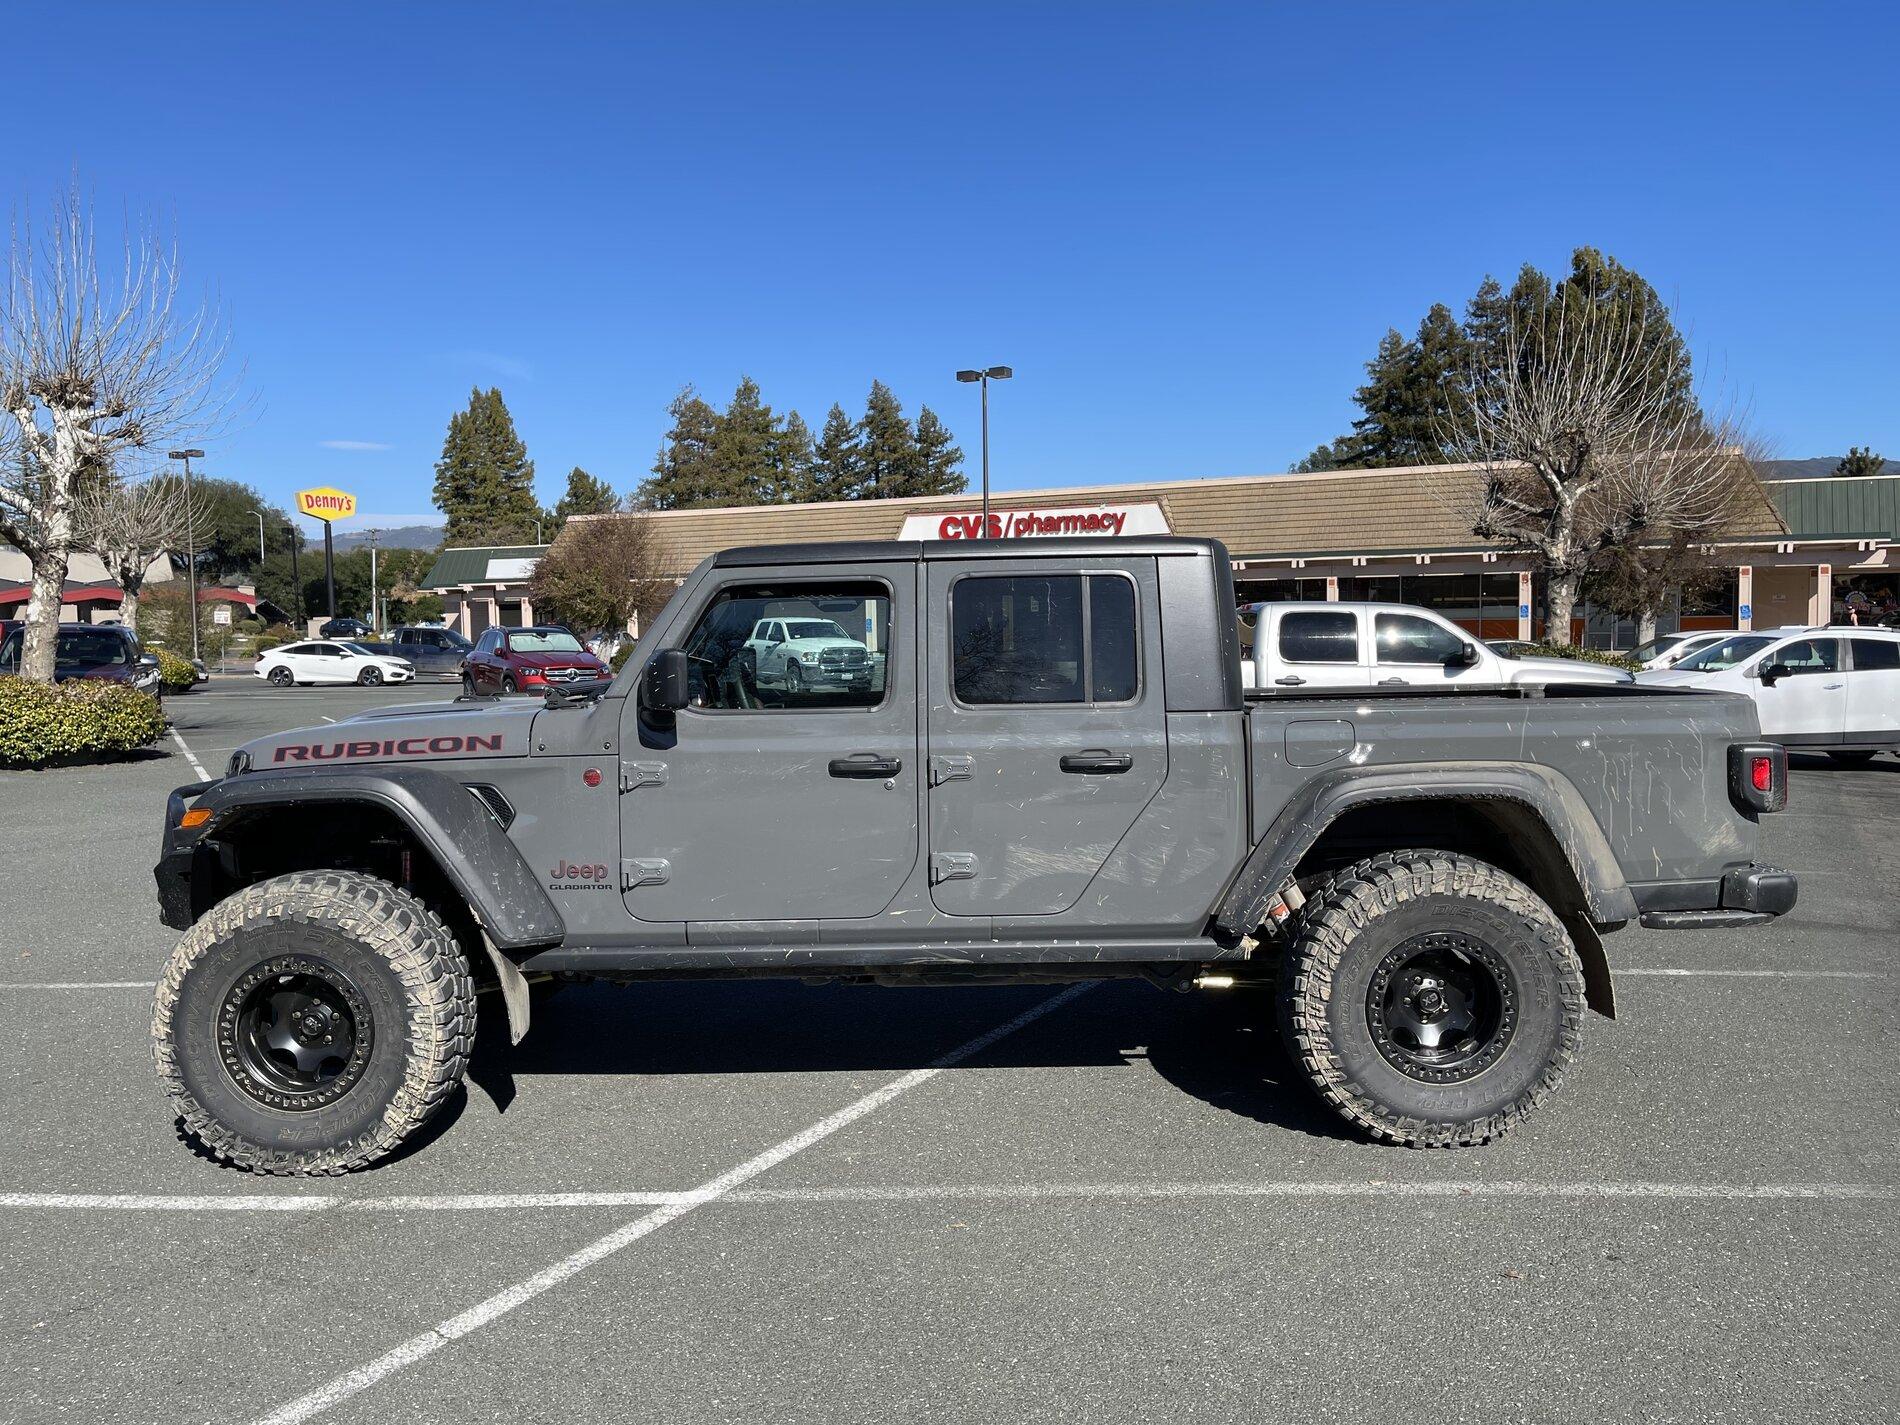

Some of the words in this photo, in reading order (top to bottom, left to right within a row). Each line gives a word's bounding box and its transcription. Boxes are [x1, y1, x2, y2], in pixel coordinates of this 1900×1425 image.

[304, 494, 352, 511] Denny's
[273, 734, 503, 763] RUBICON
[550, 859, 608, 883] Jeep
